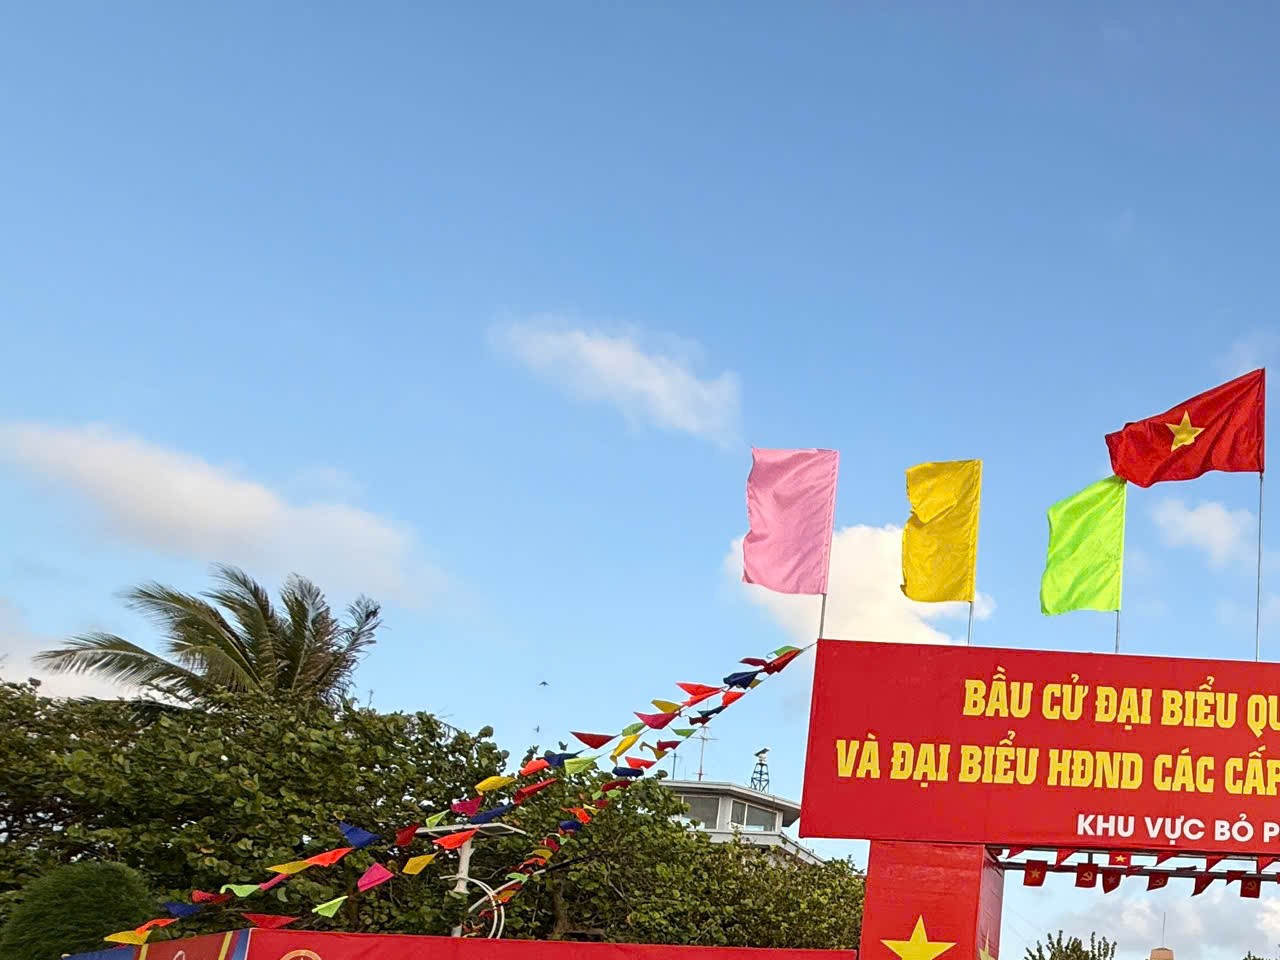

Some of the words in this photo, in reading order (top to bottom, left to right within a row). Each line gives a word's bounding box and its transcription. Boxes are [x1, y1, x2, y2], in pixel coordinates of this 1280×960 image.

[963, 666, 1032, 717] BẦU
[1042, 674, 1088, 720] CỬ
[1095, 686, 1151, 729] ĐẠI
[1161, 676, 1237, 728] BIỂU
[837, 733, 879, 778] VÀ
[890, 743, 950, 787] ĐẠI
[959, 734, 1039, 784] BIỂU
[1047, 749, 1142, 789] HĐND
[1154, 748, 1214, 792] CÁC
[1077, 814, 1134, 836] KHU
[1144, 815, 1204, 844] VỰC
[1215, 814, 1253, 841] BỎ
